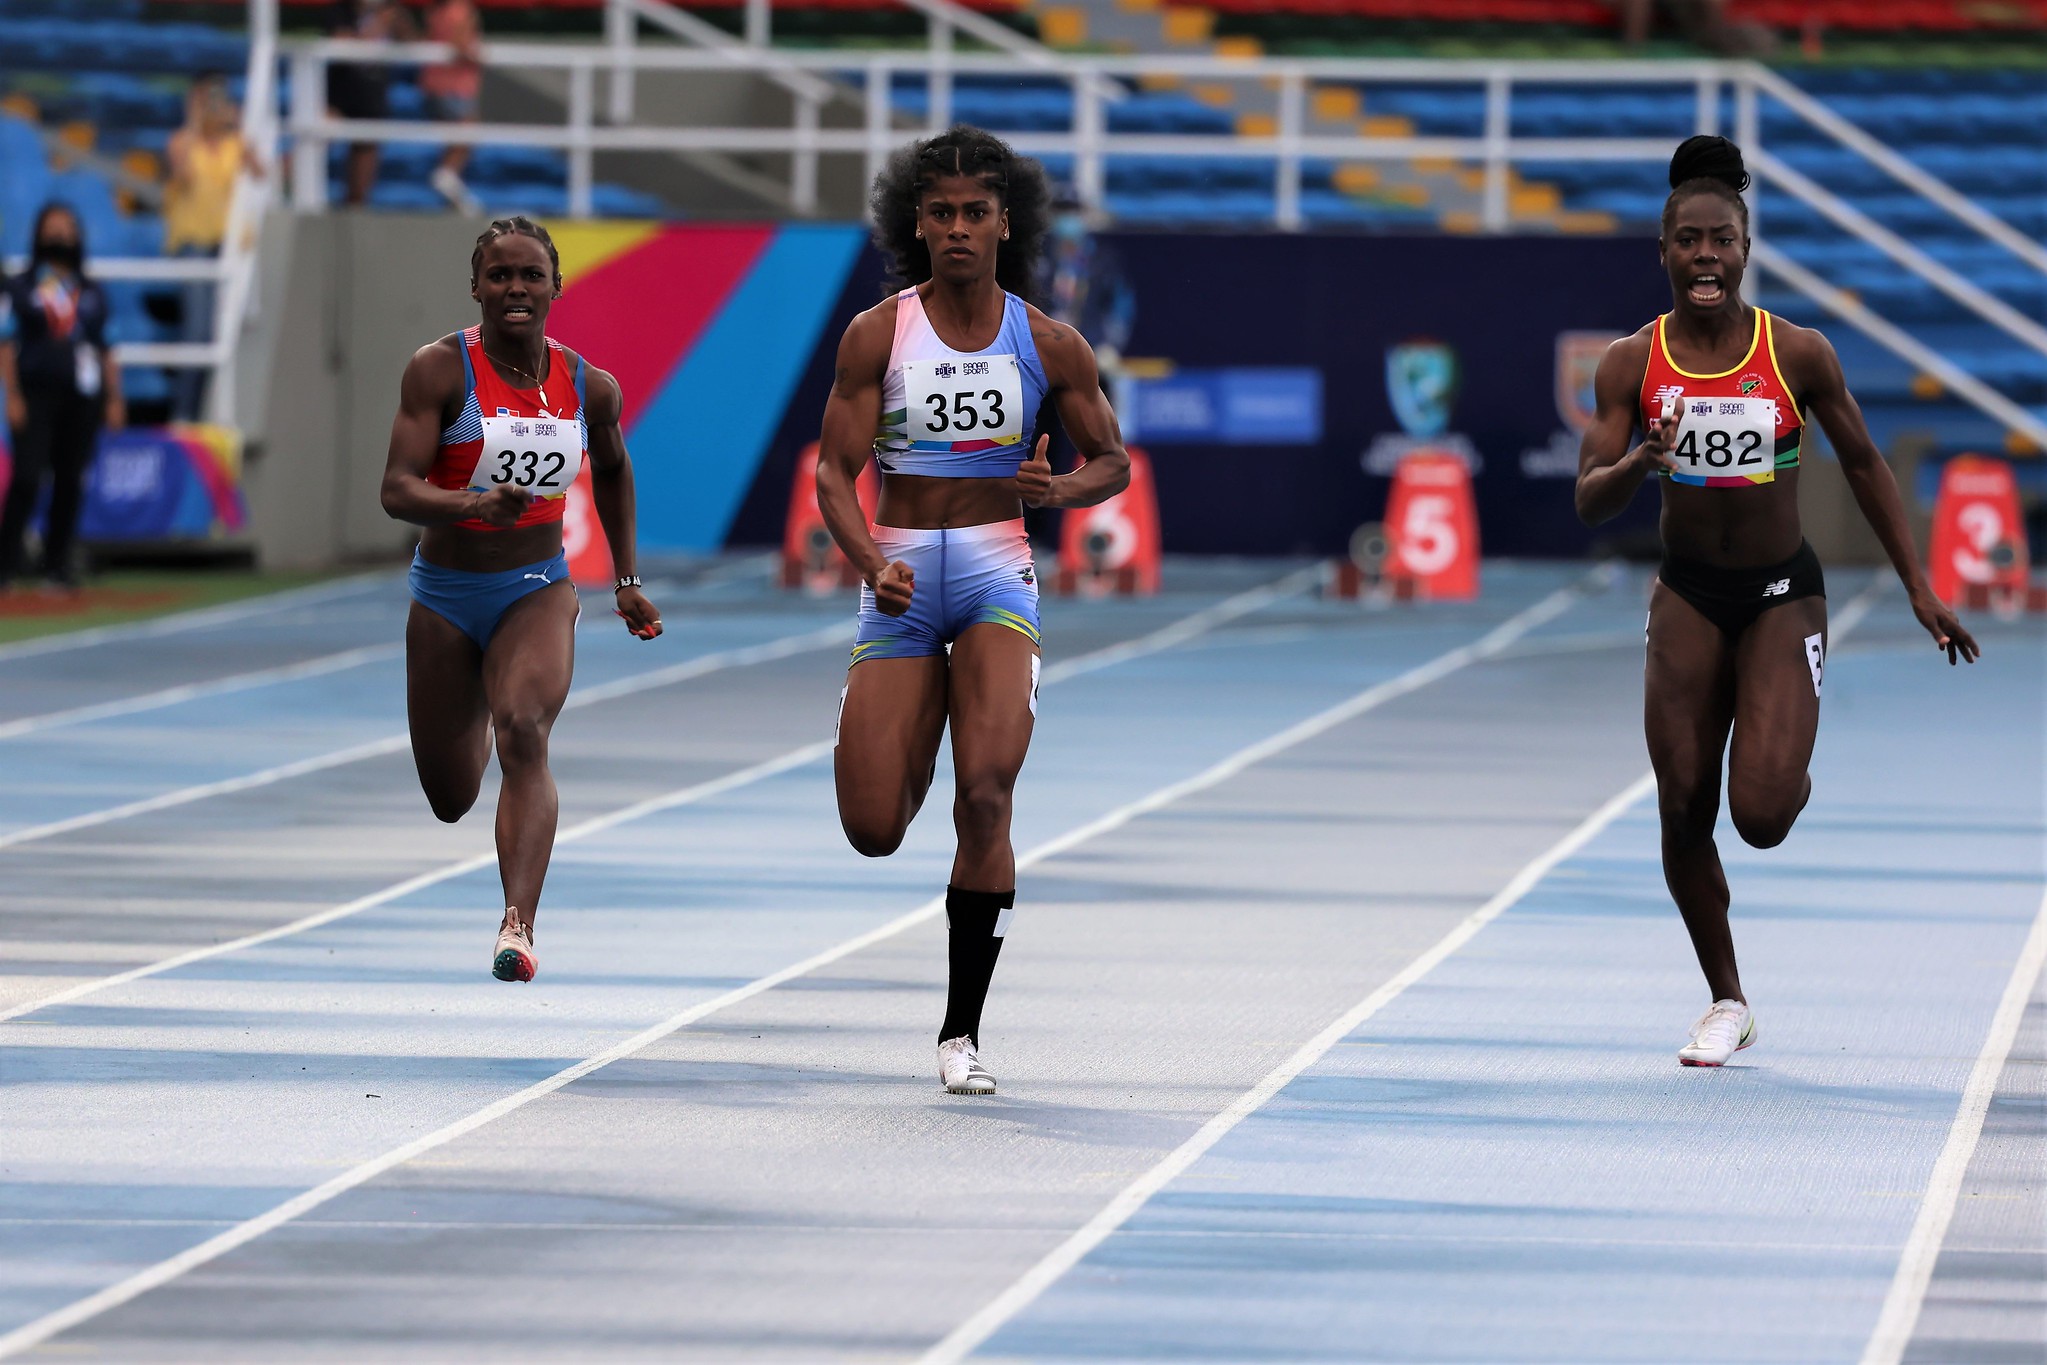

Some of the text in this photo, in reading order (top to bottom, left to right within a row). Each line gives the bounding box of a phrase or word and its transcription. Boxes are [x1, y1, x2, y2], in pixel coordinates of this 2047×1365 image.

[963, 361, 989, 369] PANAM
[963, 367, 989, 376] SPORTS
[925, 389, 1006, 433] 353
[1719, 402, 1745, 410] PANAM
[535, 423, 557, 431] PANAM
[1674, 429, 1763, 468] 482
[490, 449, 566, 488] 332
[1398, 494, 1459, 576] 5
[1952, 502, 2003, 584] 3
